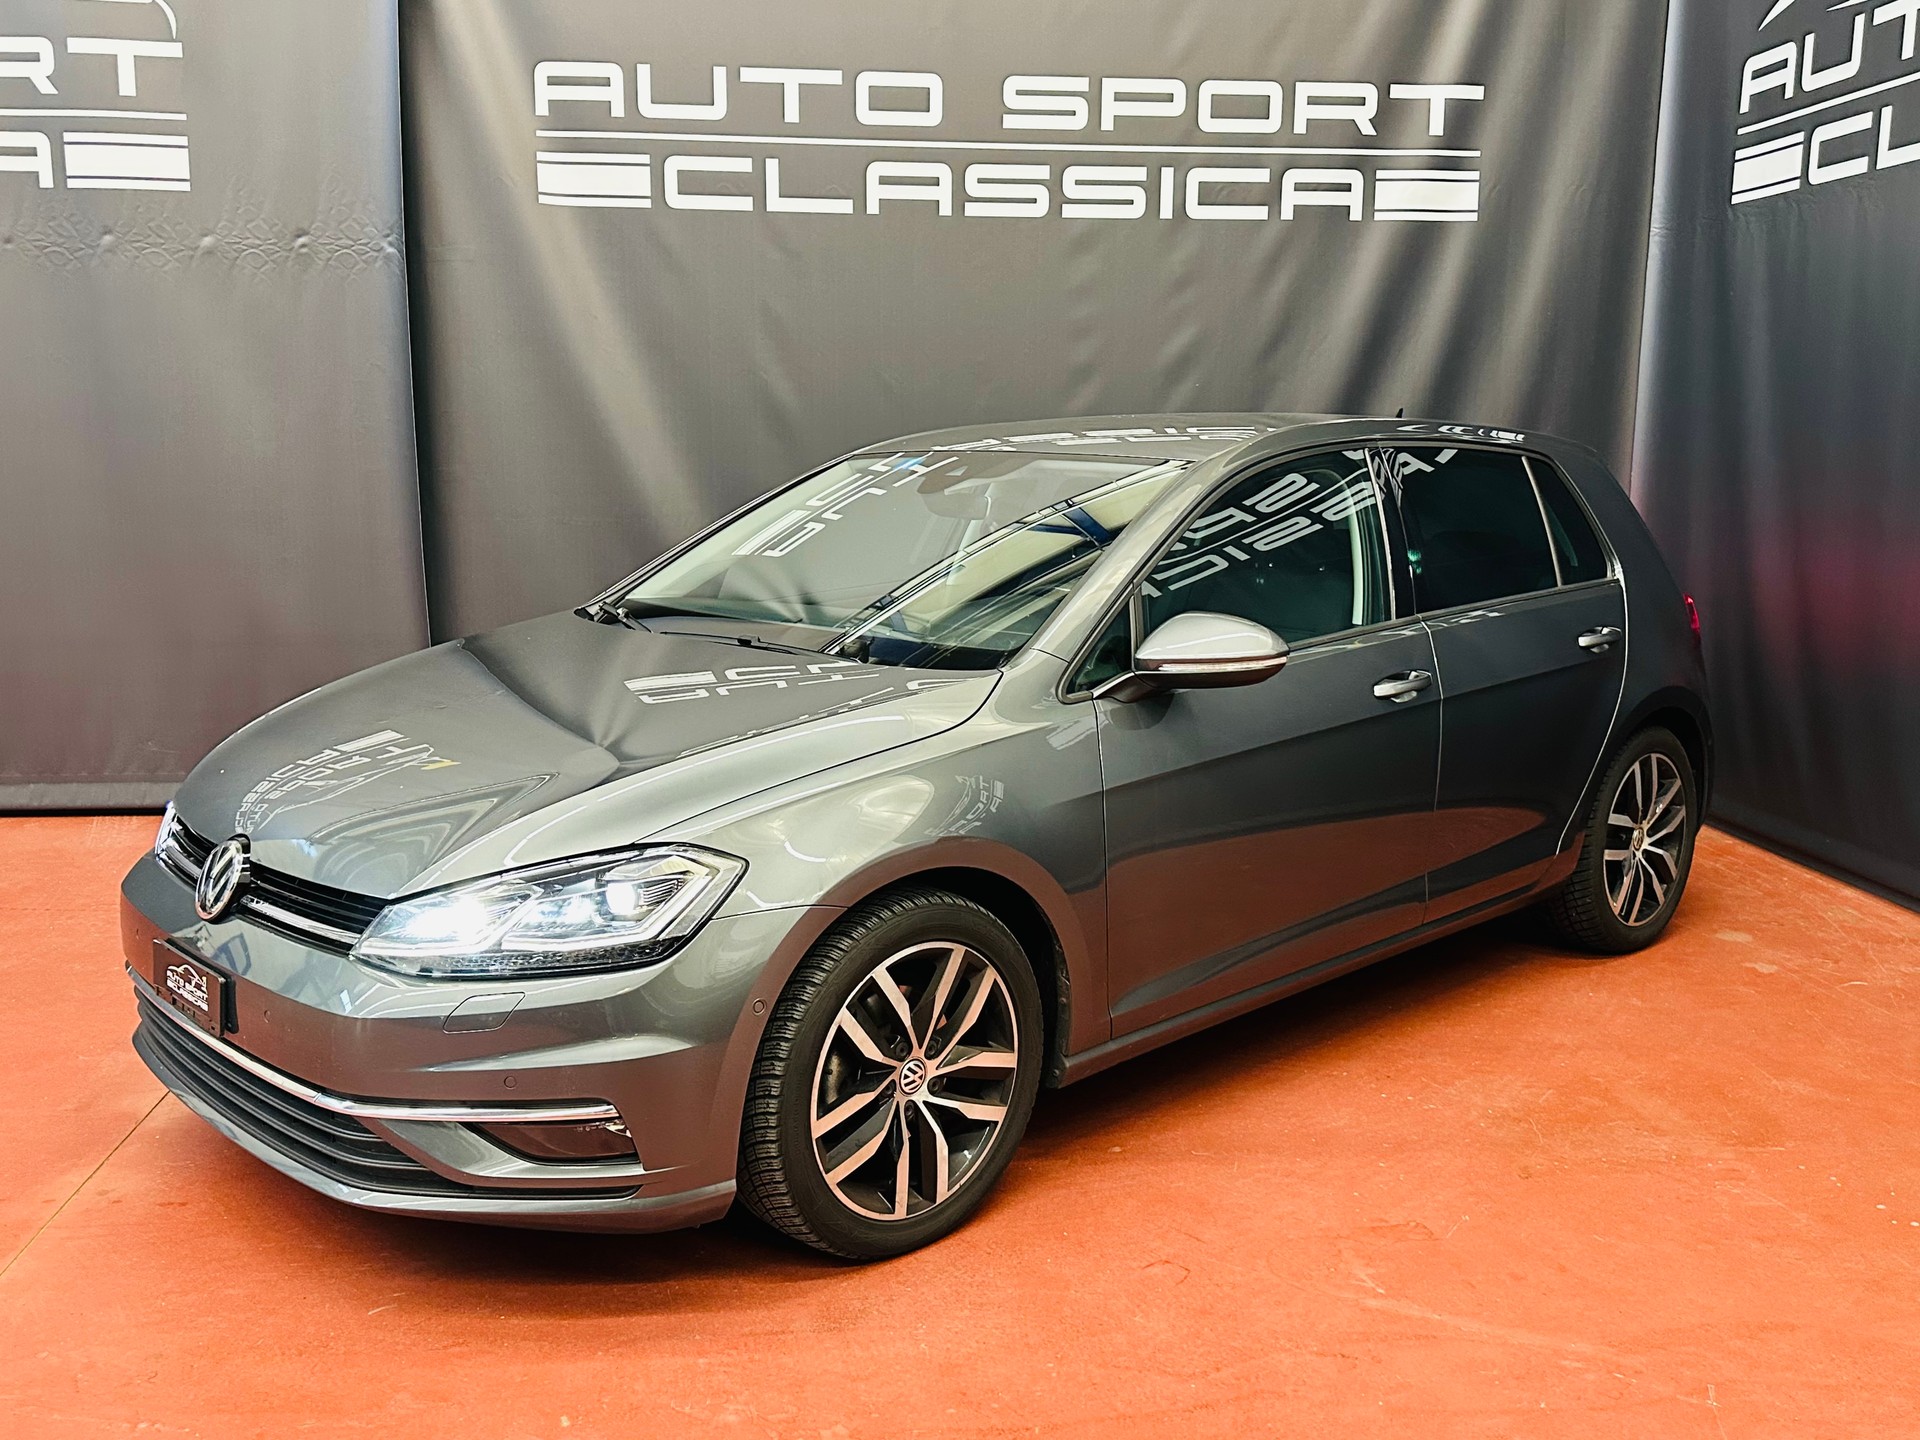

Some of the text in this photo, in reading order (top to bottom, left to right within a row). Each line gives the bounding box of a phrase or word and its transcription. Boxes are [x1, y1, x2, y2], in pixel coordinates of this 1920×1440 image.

[1739, 0, 1920, 114] AUT
[533, 61, 1486, 137] AUTO SPORT
[1808, 105, 1920, 185] CL
[663, 155, 1364, 222] CLASSICA
